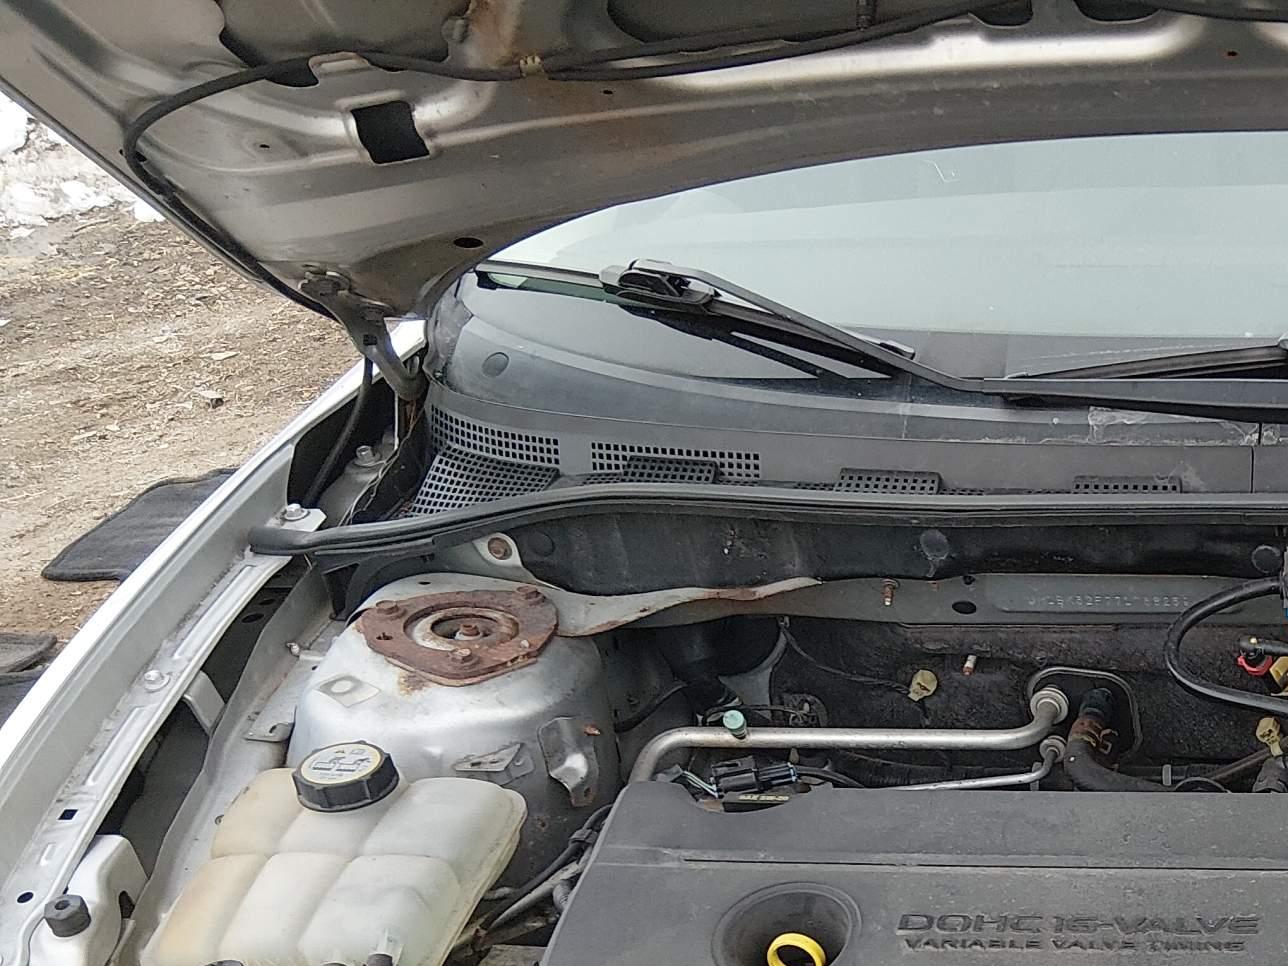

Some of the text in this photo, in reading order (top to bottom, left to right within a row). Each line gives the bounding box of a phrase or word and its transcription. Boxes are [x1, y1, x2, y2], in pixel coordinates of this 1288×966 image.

[896, 913, 1262, 935] DOHC 16-VALVE
[904, 938, 1247, 952] VARIABLE VALVE TIMING
